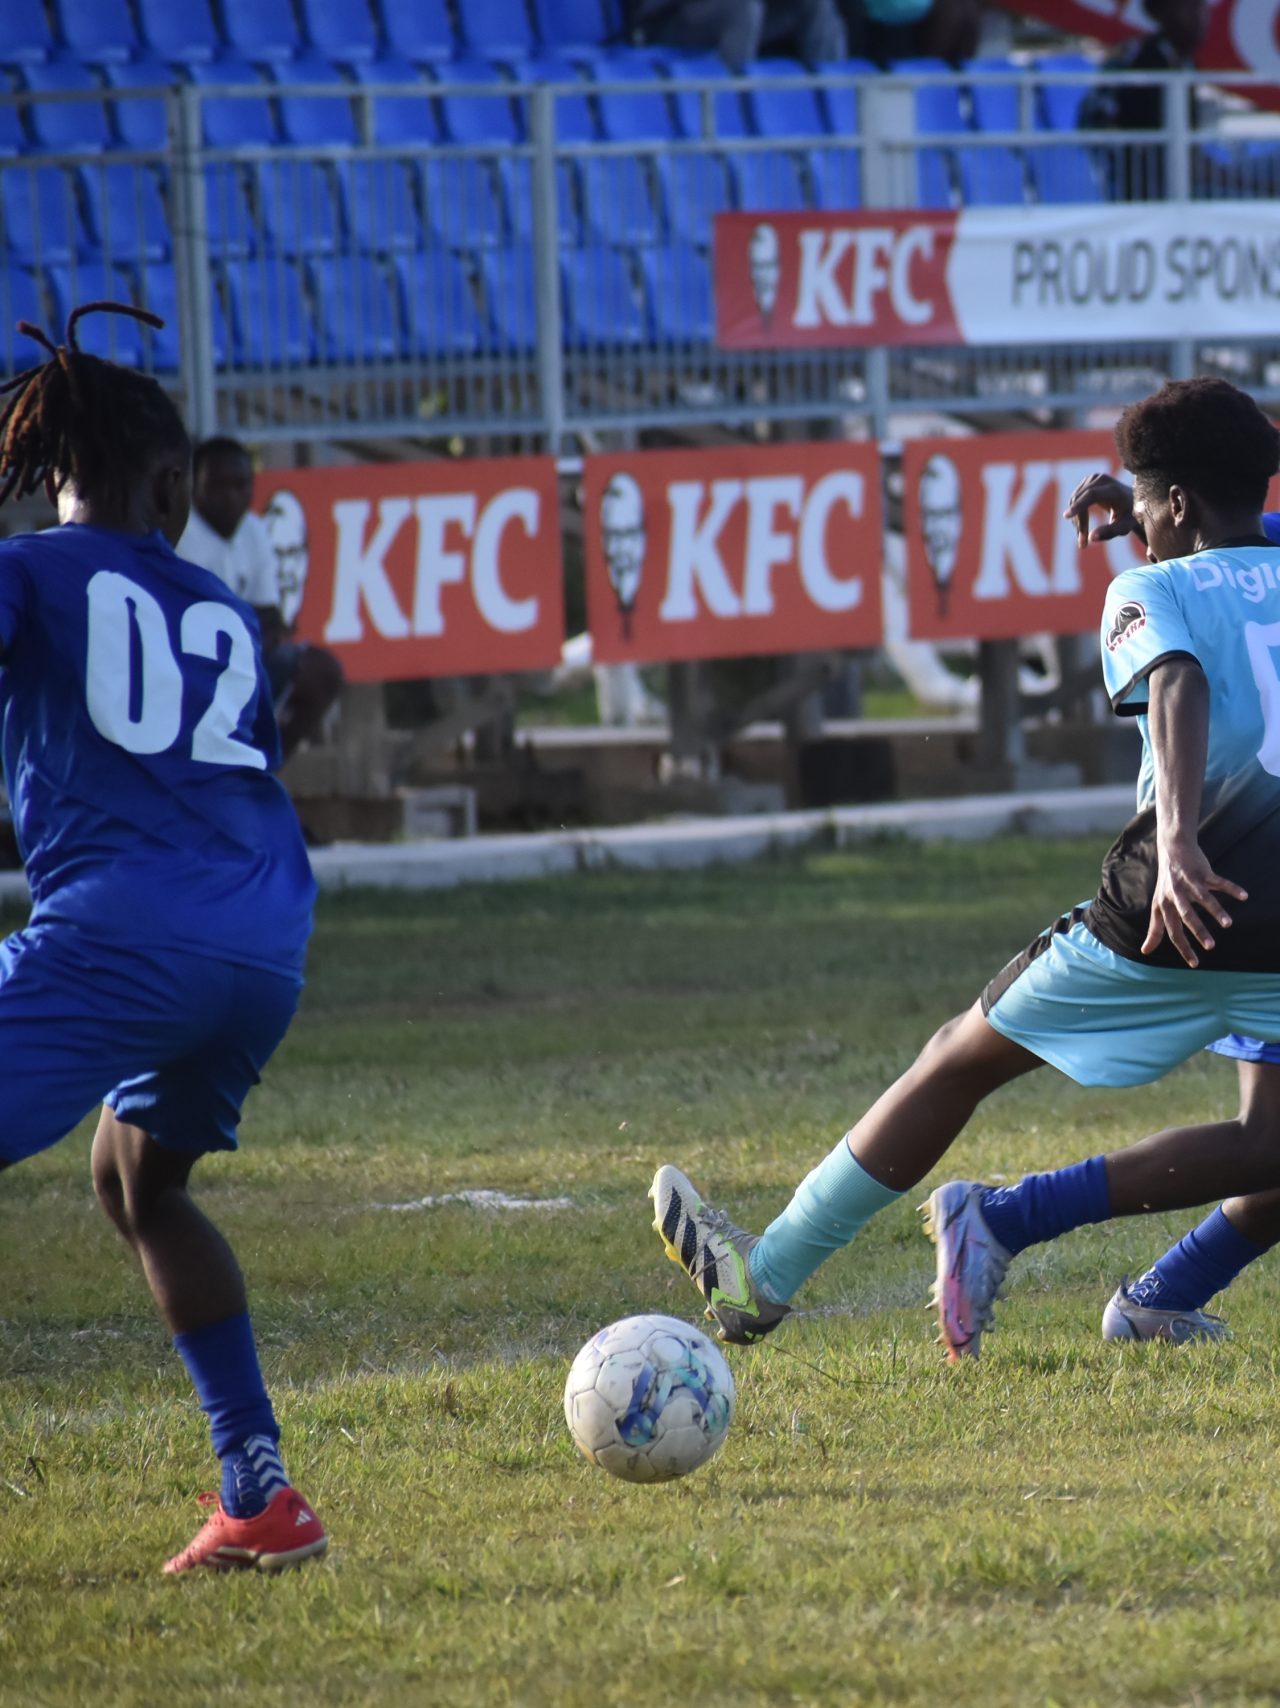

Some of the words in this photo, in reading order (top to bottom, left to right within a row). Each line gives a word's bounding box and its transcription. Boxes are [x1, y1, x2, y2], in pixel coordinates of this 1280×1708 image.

[793, 225, 934, 328] KFC
[1013, 239, 1156, 305] PROUD
[323, 487, 540, 644] KFC
[659, 469, 864, 622] KFC
[973, 459, 1148, 599] KF
[86, 570, 267, 771] 02
